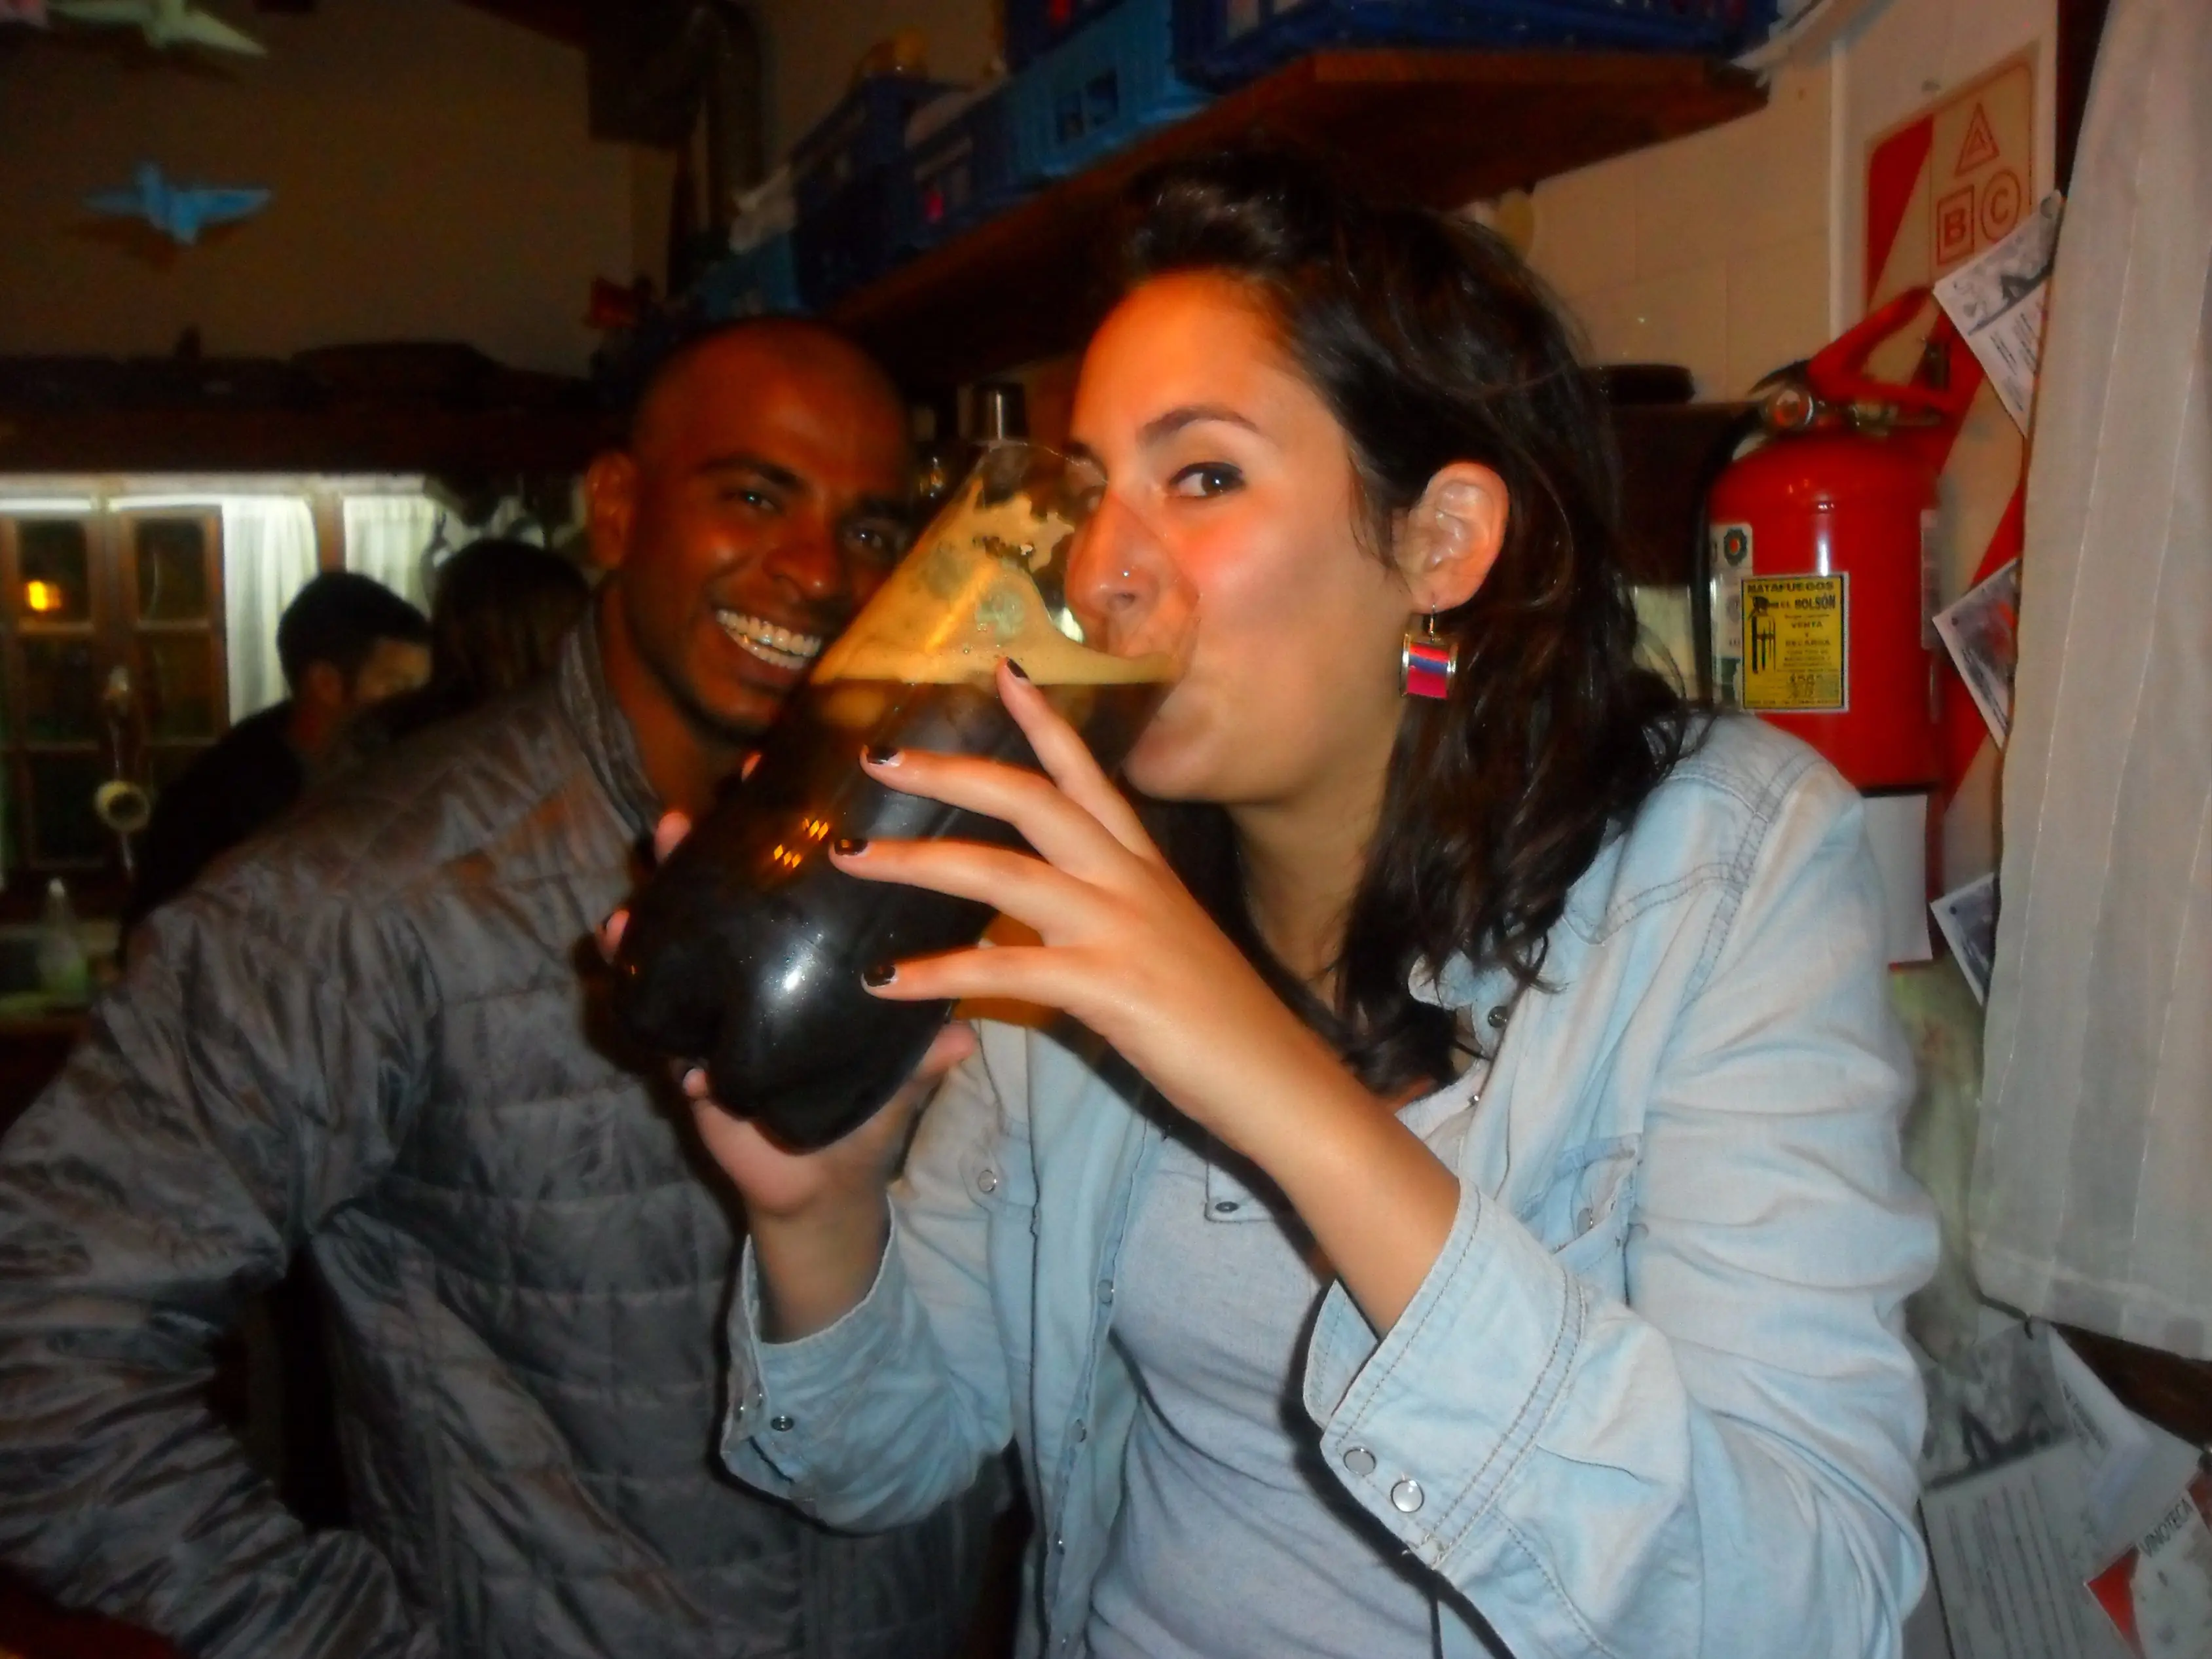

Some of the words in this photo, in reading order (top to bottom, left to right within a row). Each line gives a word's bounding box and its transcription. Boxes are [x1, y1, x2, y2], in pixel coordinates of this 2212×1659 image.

[1944, 208, 1966, 247] B
[1990, 187, 2009, 224] C
[1747, 581, 1834, 593] MATAFUEGOS
[2138, 1497, 2194, 1558] VINOTECA
